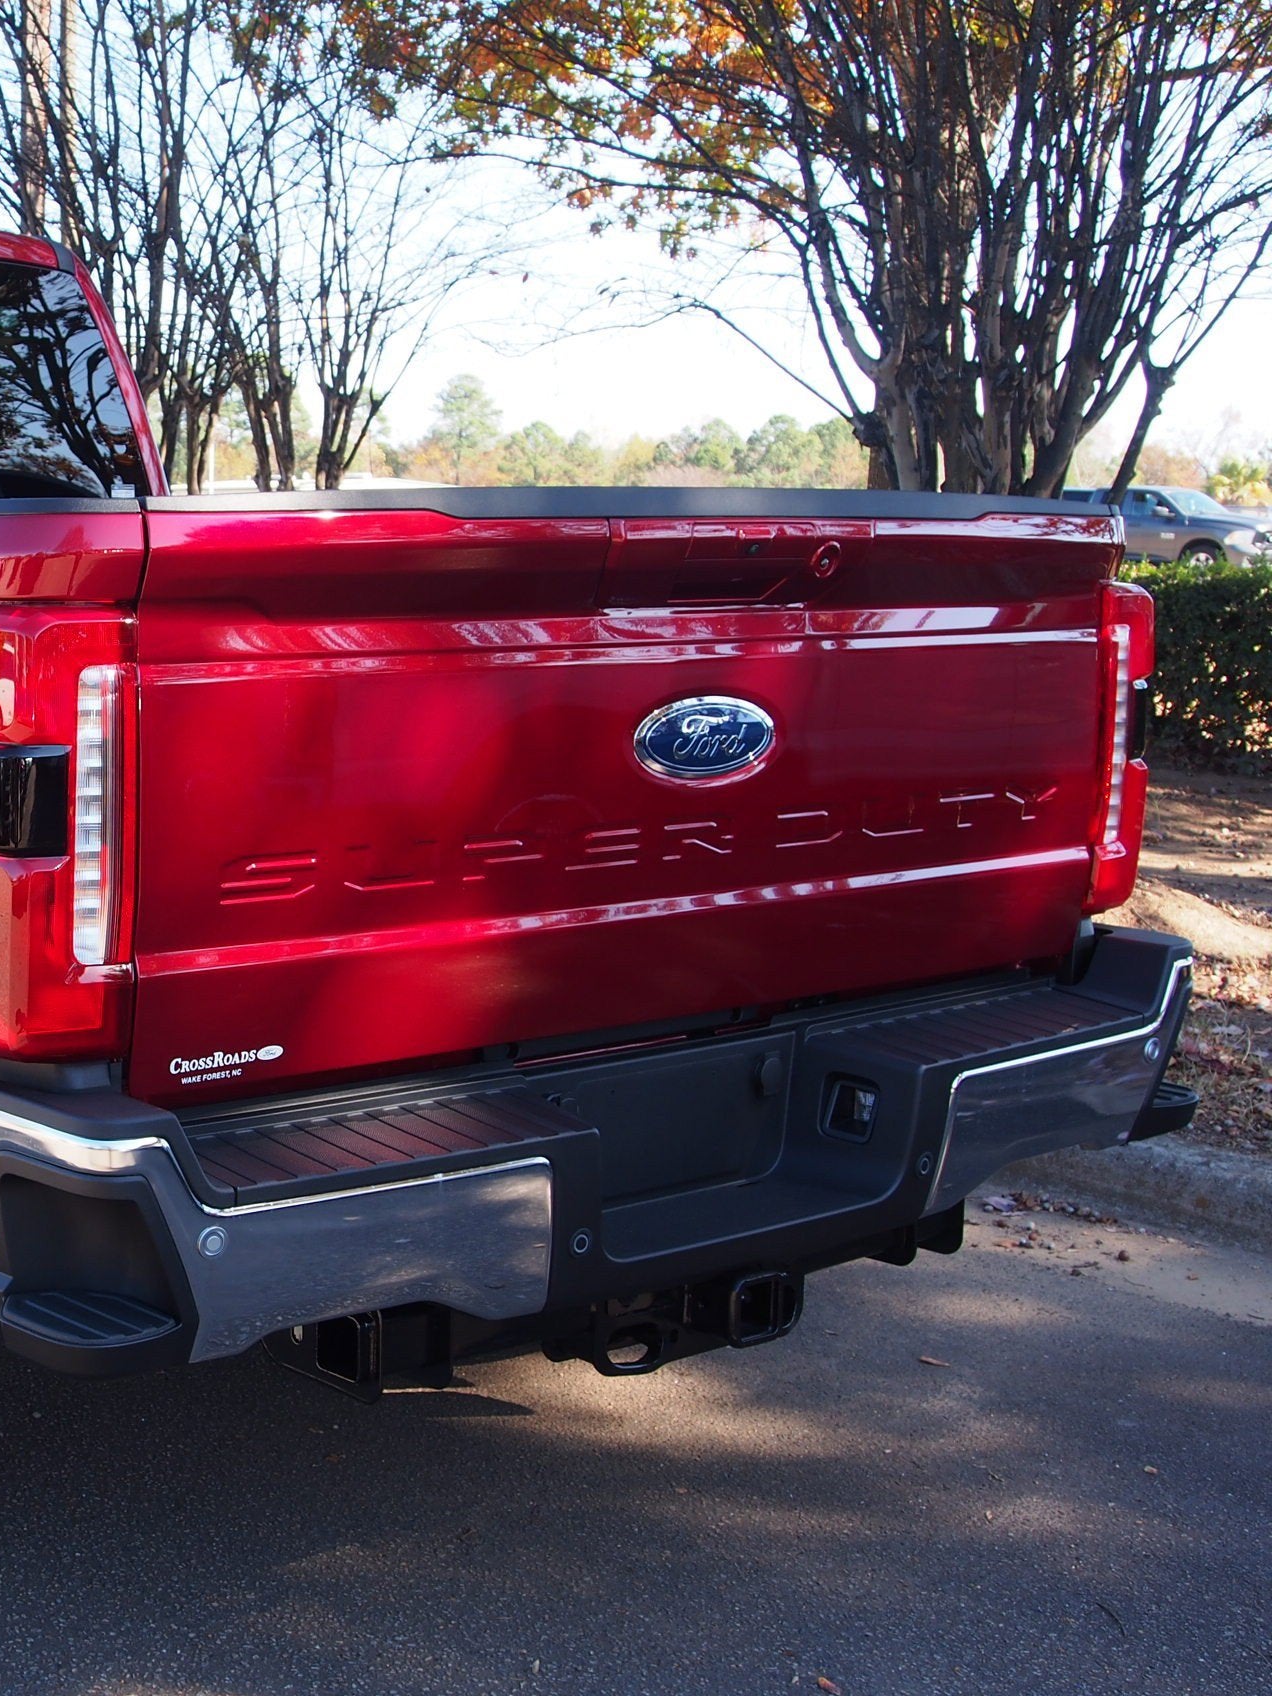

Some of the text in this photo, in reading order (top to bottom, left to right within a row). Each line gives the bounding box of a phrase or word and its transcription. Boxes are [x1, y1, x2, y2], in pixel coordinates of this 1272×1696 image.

[673, 714, 748, 759] Ford
[220, 787, 1059, 905] SUPER DUTY
[181, 1068, 243, 1085] WAKE FOREST, NC
